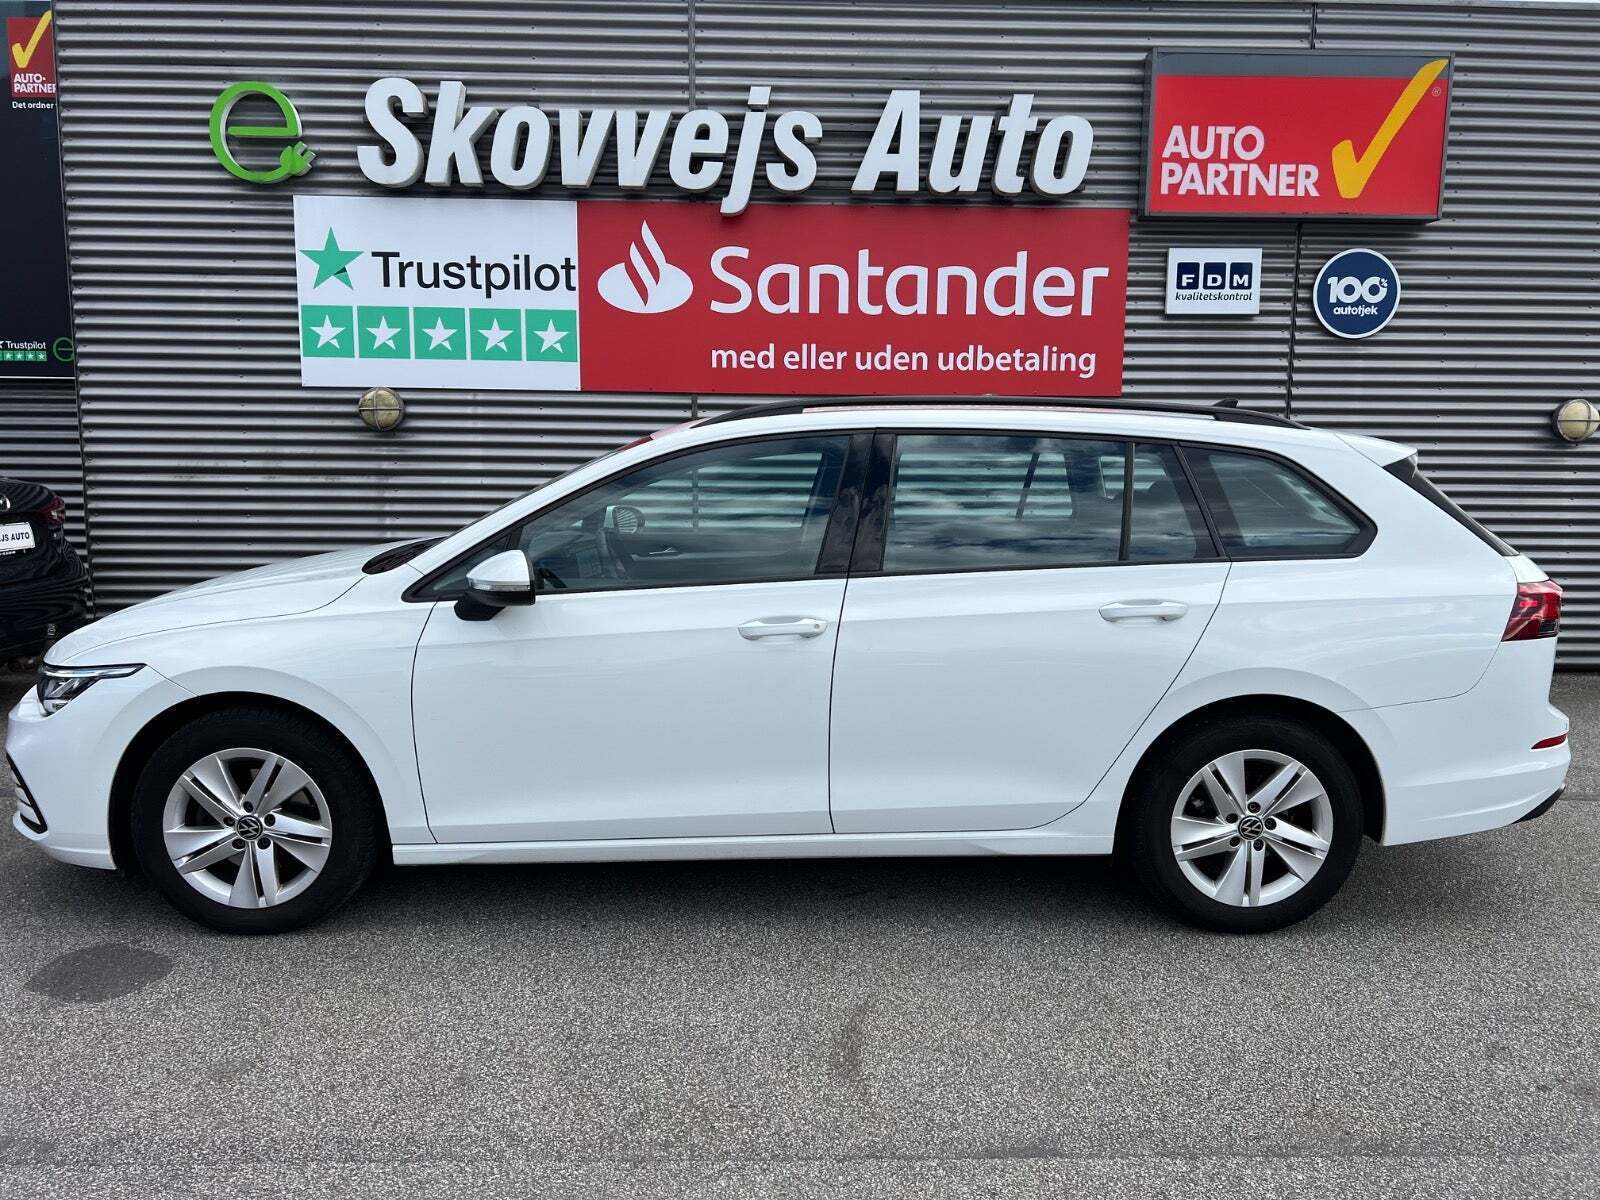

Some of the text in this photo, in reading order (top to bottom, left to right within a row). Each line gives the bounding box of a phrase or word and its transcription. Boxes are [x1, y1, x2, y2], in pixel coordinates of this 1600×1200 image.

[12, 101, 26, 109] Det
[27, 101, 54, 109] ordner
[357, 77, 1094, 216] Skovvejs Auto
[1162, 125, 1265, 161] AUTO
[1160, 162, 1320, 197] PARTNER
[371, 251, 577, 299] Trustpilot
[710, 246, 1109, 317] Santander
[1175, 291, 1253, 301] kvalitetskontrol
[1333, 305, 1378, 317] autotjek
[5, 340, 46, 350] Trustpilot
[711, 343, 1096, 378] med eller uden udbetaling
[0, 531, 30, 542] JS AUTO
